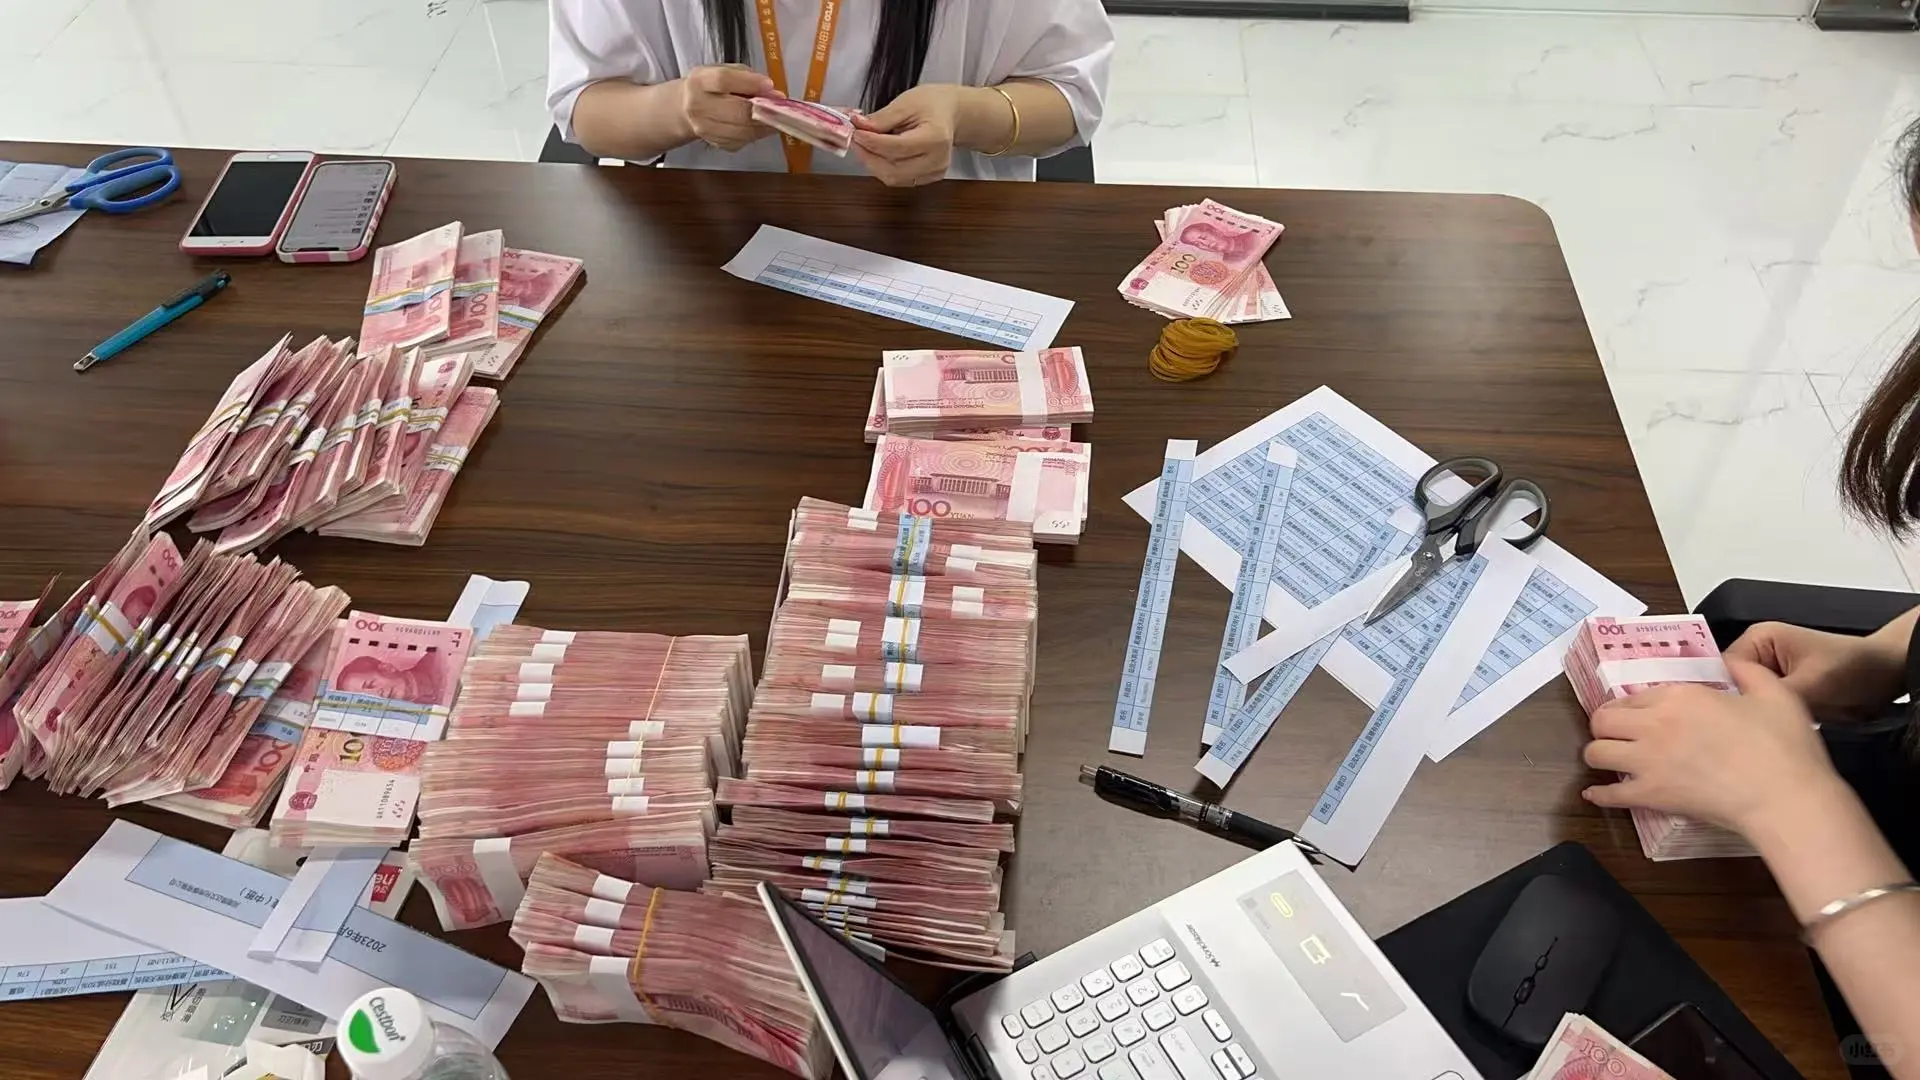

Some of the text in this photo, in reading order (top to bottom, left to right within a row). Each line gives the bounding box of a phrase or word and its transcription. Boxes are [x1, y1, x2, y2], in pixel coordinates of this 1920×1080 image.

[1171, 254, 1196, 275] 100
[906, 498, 951, 518] 100
[1598, 625, 1627, 635] 100
[339, 733, 364, 762] 10
[369, 997, 400, 1041] Cestbon
[1577, 1037, 1627, 1078] 100
